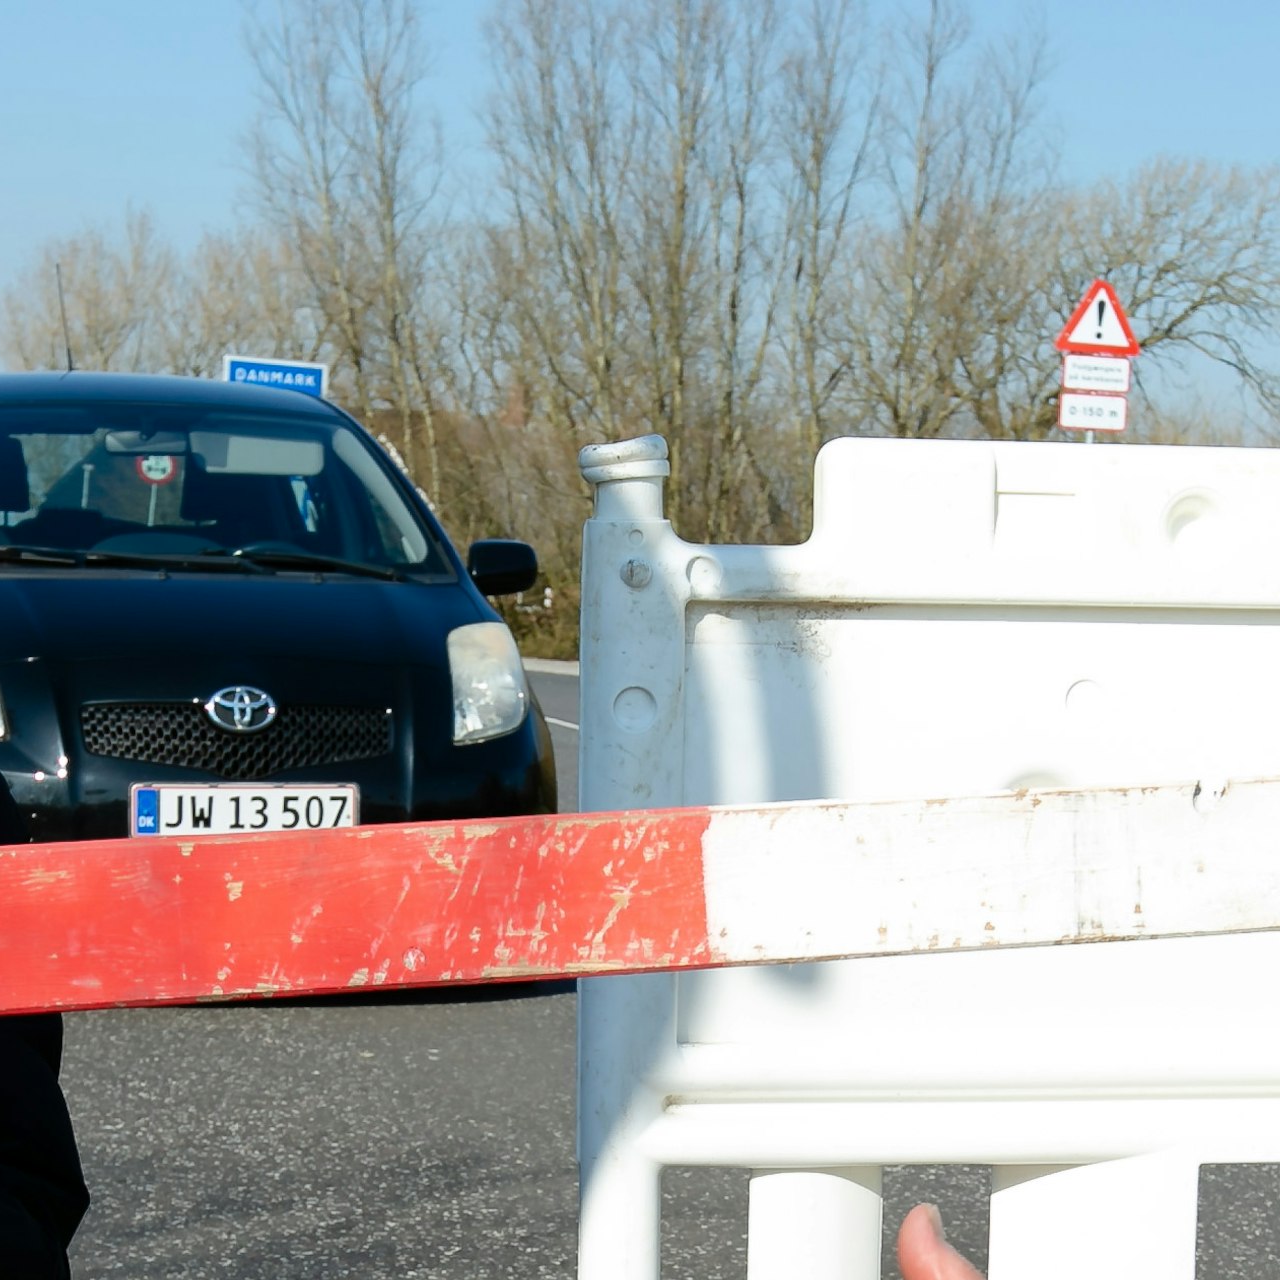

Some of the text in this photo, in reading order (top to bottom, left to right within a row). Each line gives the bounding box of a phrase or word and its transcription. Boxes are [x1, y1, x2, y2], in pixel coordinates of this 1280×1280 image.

[235, 366, 317, 387] DANMARK
[138, 815, 155, 828] DK
[165, 796, 348, 829] JW 13 507
